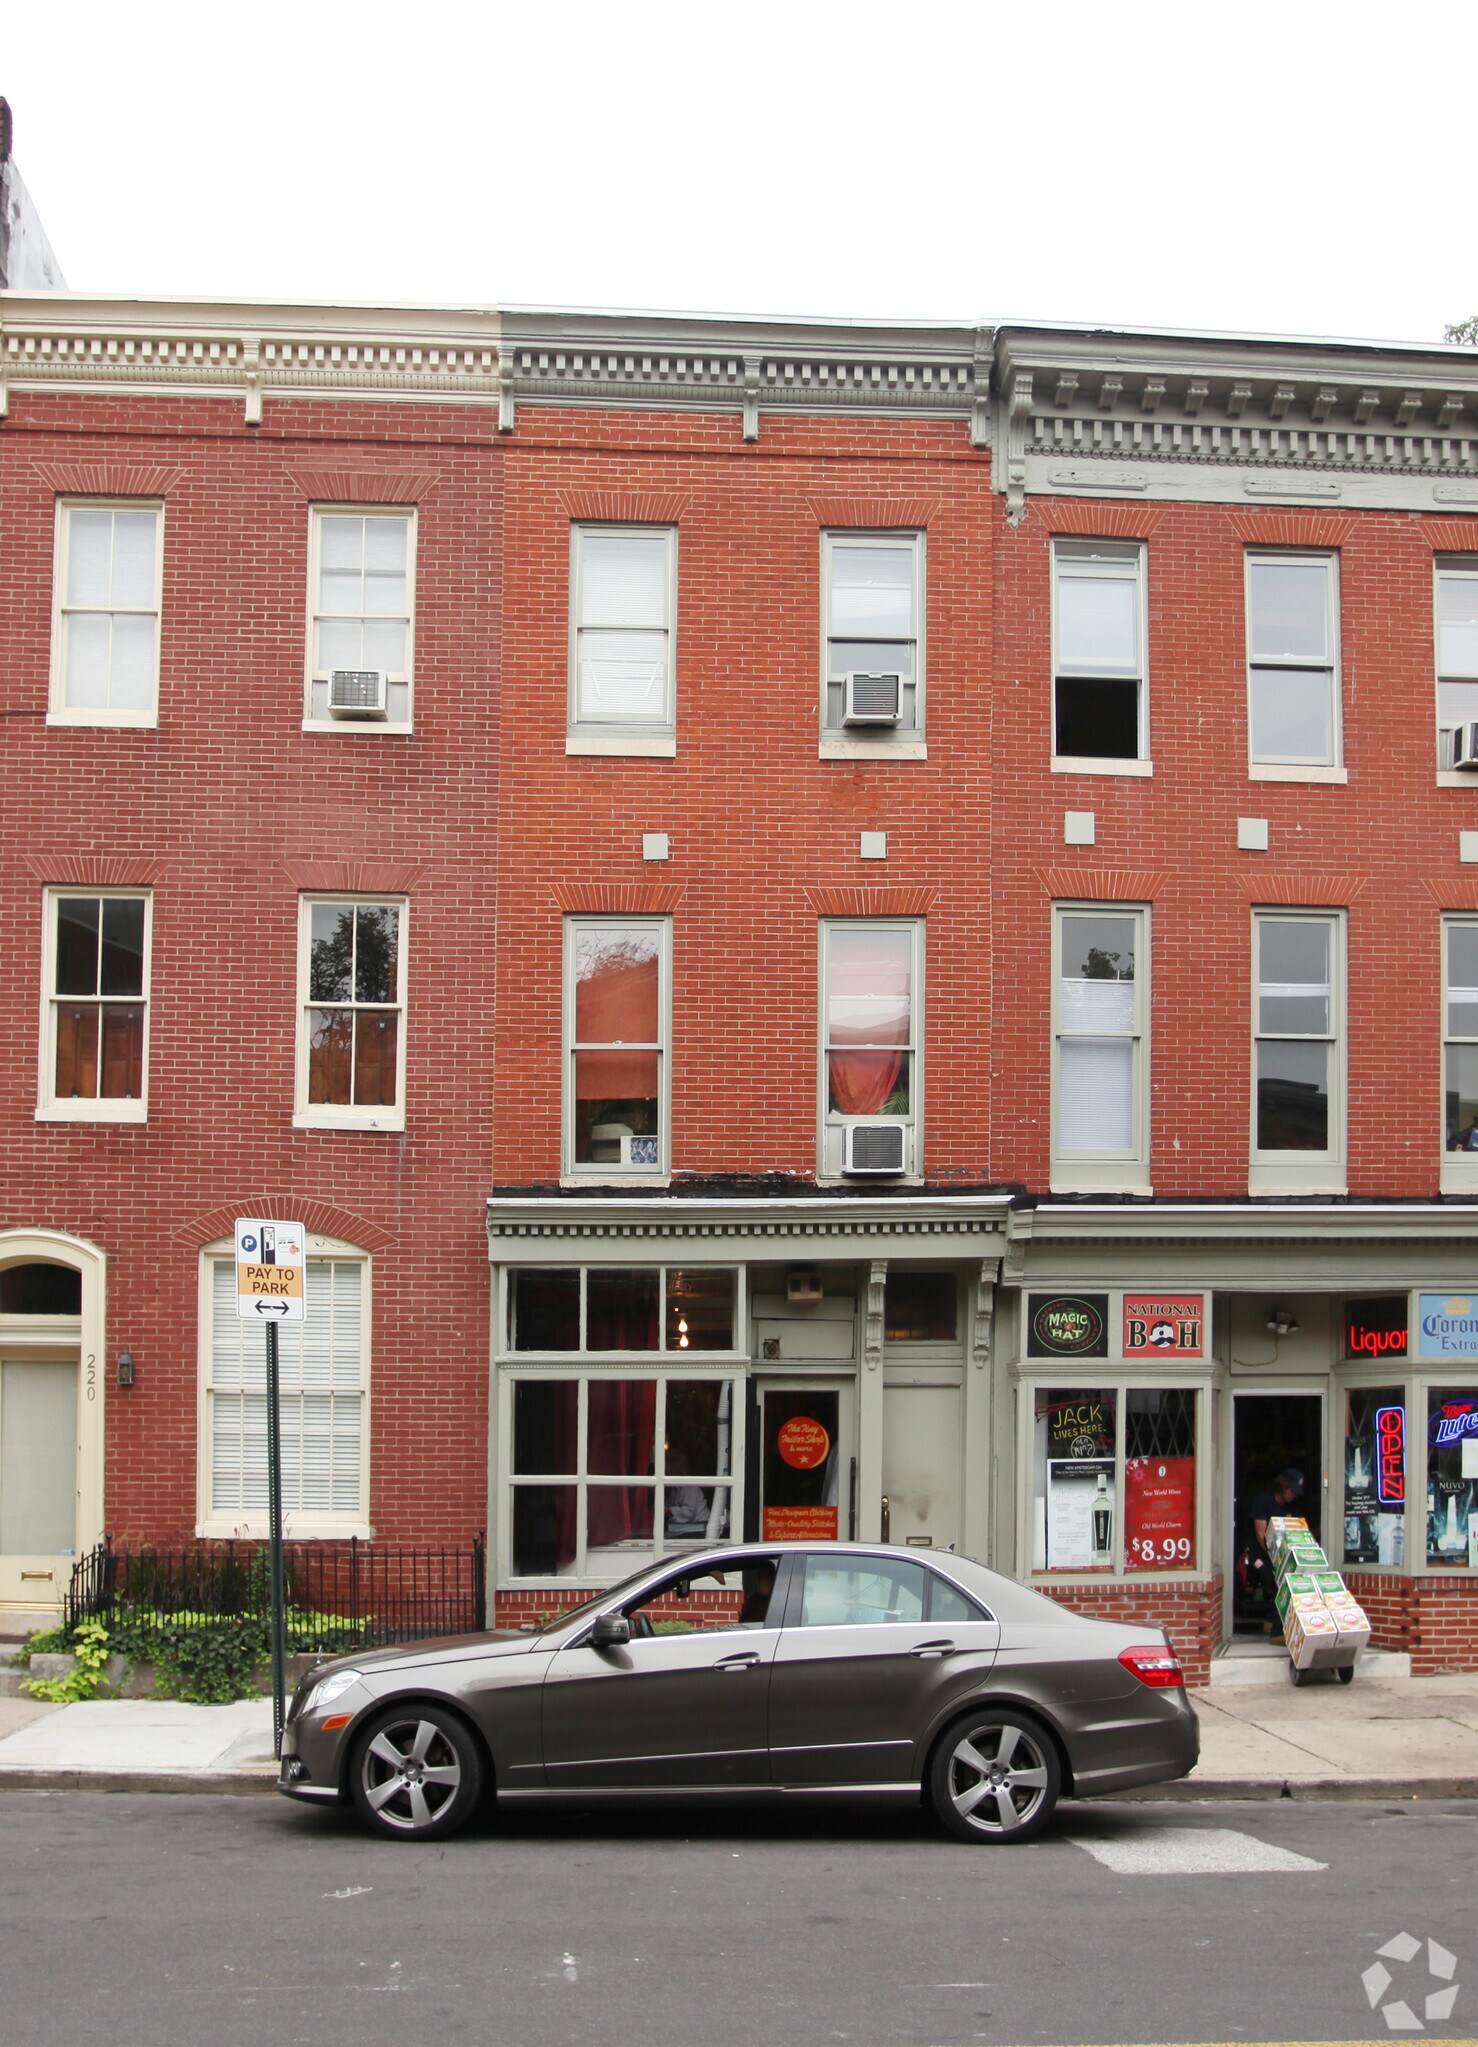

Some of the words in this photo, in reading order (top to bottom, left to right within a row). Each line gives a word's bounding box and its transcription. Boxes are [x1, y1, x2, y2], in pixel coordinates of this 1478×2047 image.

[247, 1266, 272, 1280] PAY
[276, 1268, 295, 1281] TO
[252, 1281, 290, 1295] PARK
[1126, 1303, 1201, 1317] NATIONAL
[1049, 1312, 1088, 1327] MAGIC
[1052, 1328, 1083, 1340] HAT
[1441, 1336, 1477, 1351] Extra
[87, 1353, 96, 1401] 220
[1053, 1403, 1103, 1429] JACK
[786, 1423, 801, 1433] The
[1053, 1427, 1079, 1441] LIVES
[1435, 1412, 1478, 1443] Lite
[804, 1434, 825, 1446] Shop
[1379, 1411, 1404, 1500] OPEN
[1141, 1489, 1153, 1497] New
[1153, 1488, 1168, 1496] World
[1438, 1481, 1465, 1490] NUVO
[1141, 1522, 1151, 1530] Old
[1132, 1537, 1191, 1562] $8.99
